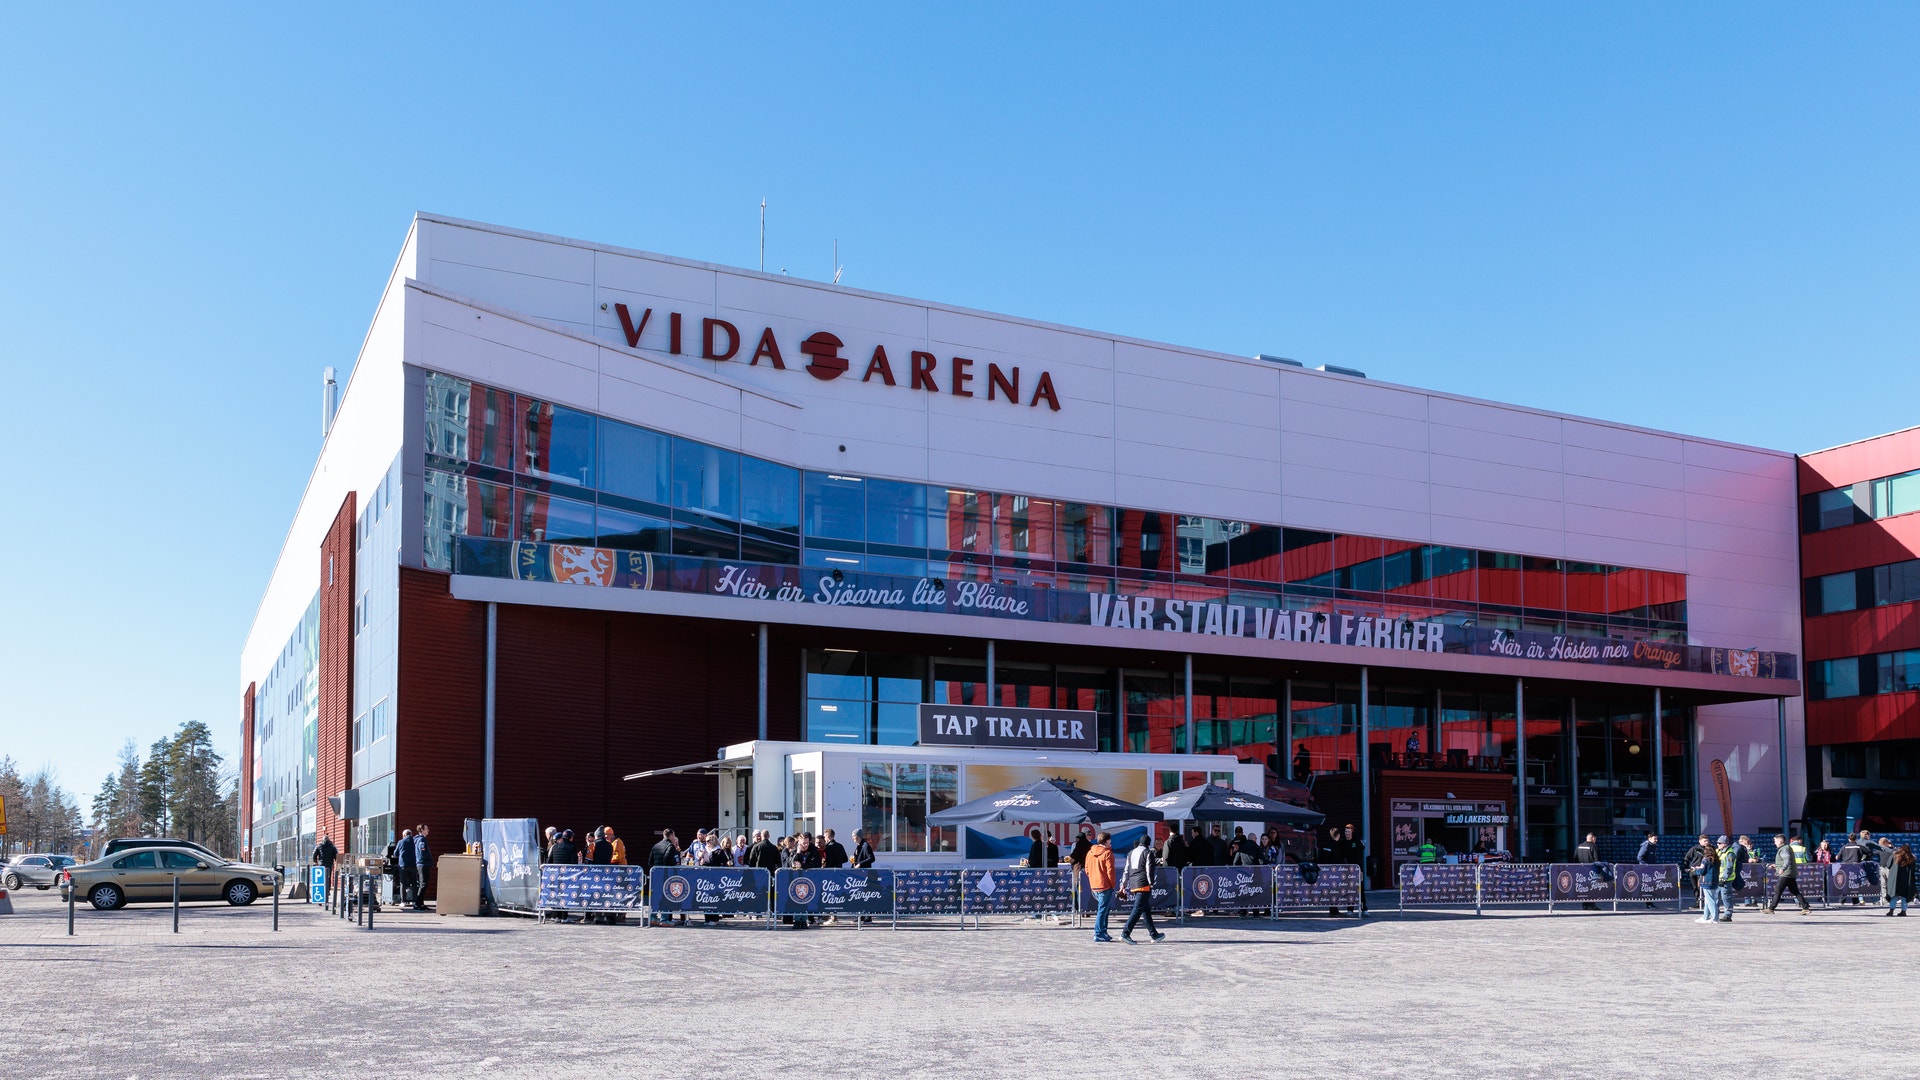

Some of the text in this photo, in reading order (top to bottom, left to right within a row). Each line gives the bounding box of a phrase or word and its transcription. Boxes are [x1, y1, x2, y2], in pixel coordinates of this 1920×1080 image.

[614, 303, 1061, 412] VIDA ARENA
[714, 565, 1028, 616] Här är Sjöarna lite Blåare
[1090, 593, 1444, 653] VÅR STAD VÅRA FÄRGER
[1490, 629, 1681, 669] Här är Hösten mer Orange
[933, 714, 1086, 740] TAP TRAILER
[1464, 815, 1491, 824] LAKERS
[315, 869, 322, 883] P
[696, 878, 716, 891] Vår
[718, 876, 744, 889] Stad
[822, 880, 841, 892] Vår
[844, 876, 868, 890] Stad
[696, 888, 756, 904] Våra Färger
[822, 888, 882, 904] Våra Färger
